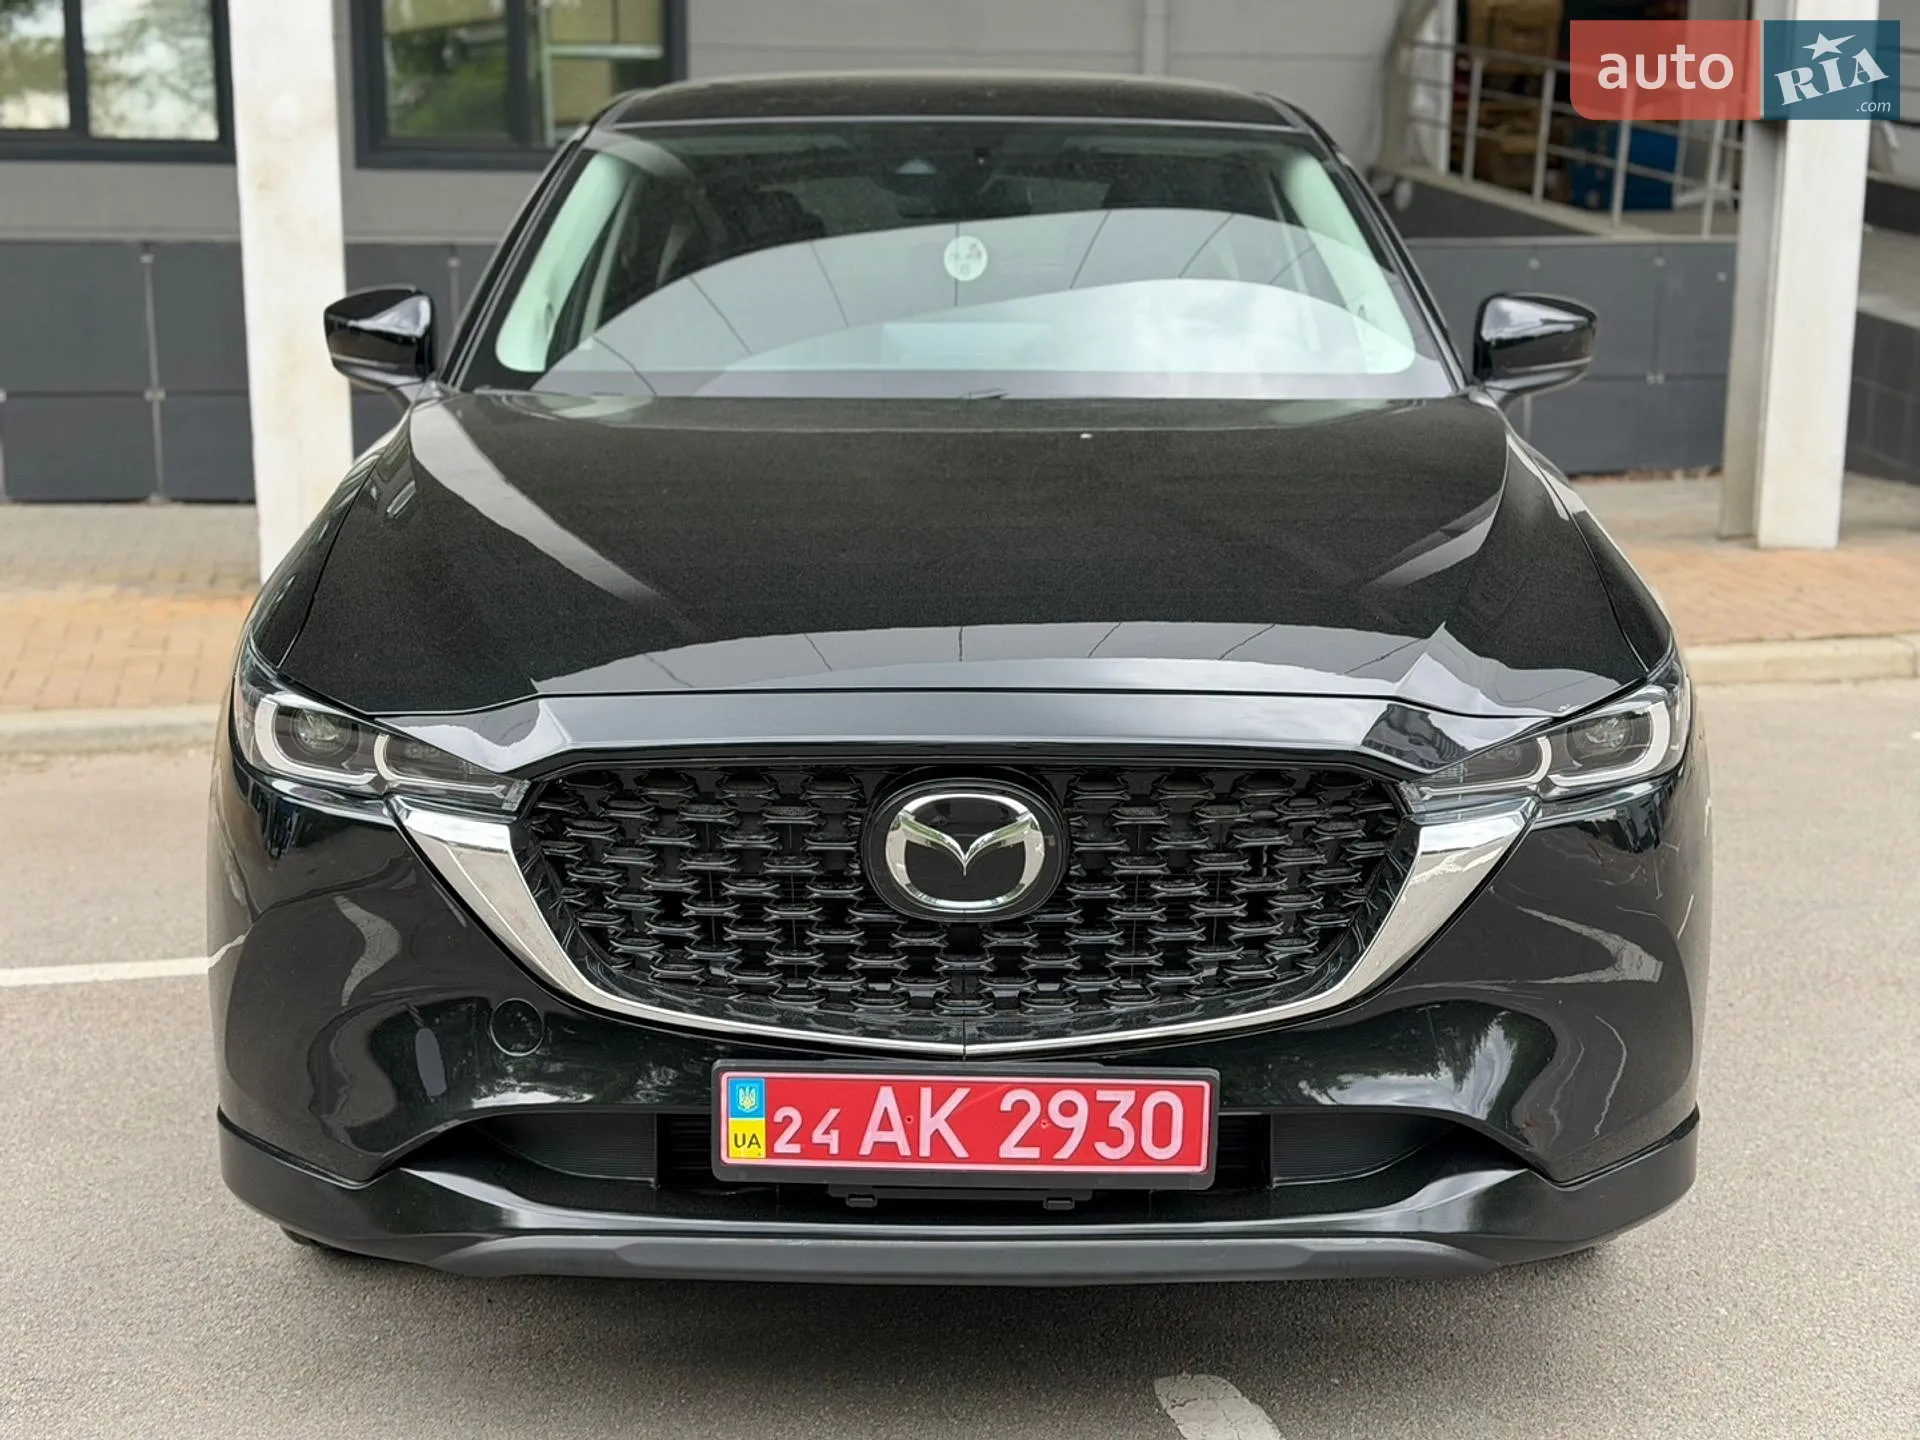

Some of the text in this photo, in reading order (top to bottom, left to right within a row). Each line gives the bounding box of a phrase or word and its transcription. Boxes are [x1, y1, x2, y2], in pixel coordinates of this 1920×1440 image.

[734, 1133, 762, 1149] UA
[773, 1086, 1184, 1161] 24 AK 2930
